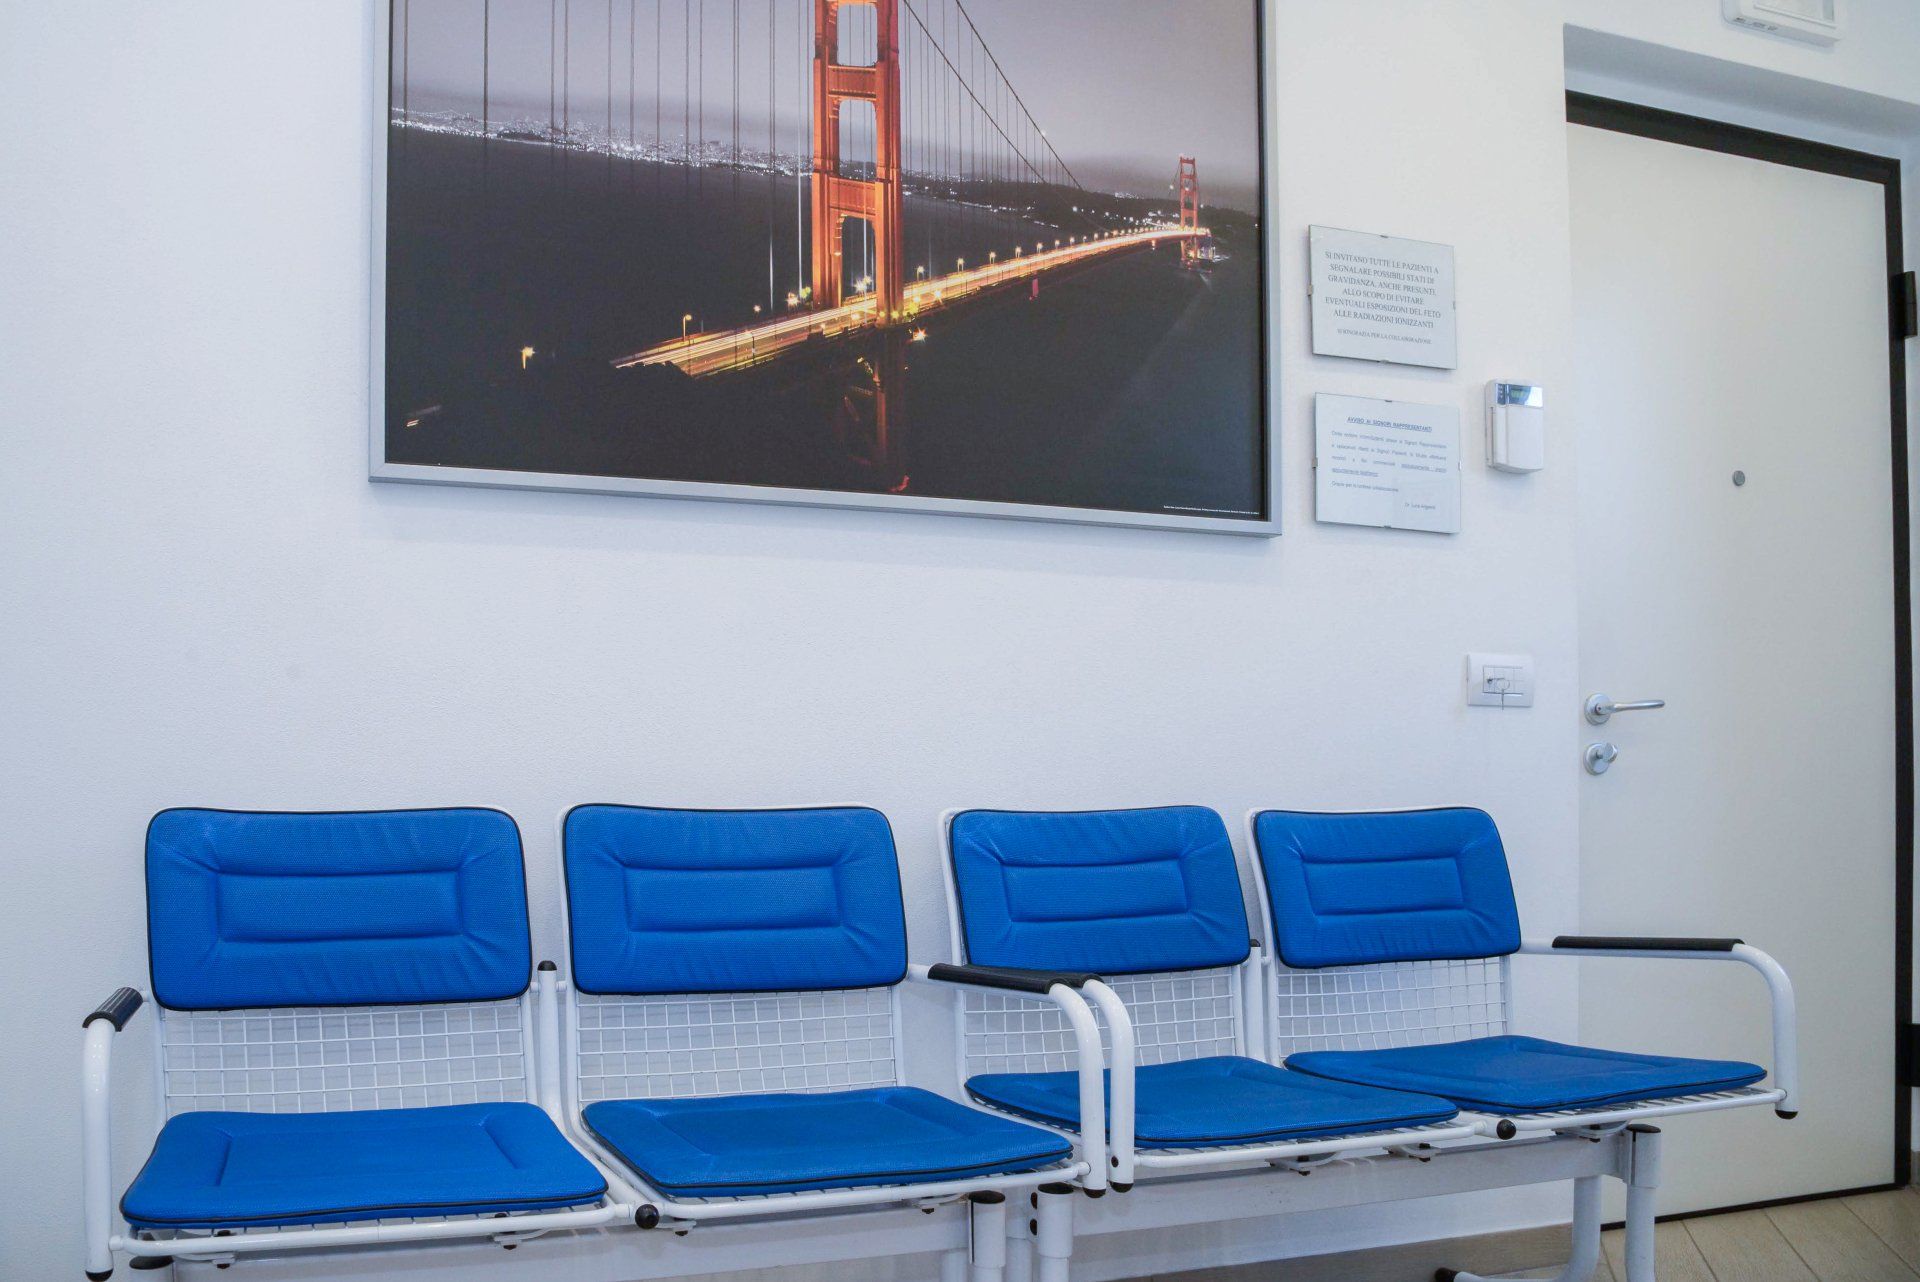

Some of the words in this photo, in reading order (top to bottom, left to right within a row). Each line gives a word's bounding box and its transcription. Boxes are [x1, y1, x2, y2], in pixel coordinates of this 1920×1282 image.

[1333, 253, 1368, 264] INVITANO
[1370, 258, 1390, 267] TUTTE
[1402, 262, 1433, 273] PAZIENTI
[1330, 264, 1372, 275] SEGNALARE
[1374, 270, 1405, 281] POSSIBILI
[1407, 274, 1426, 283] STATI
[1378, 282, 1401, 290] ANCHE
[1343, 289, 1361, 297] ALLO
[1362, 291, 1385, 300] SCOPO
[1395, 295, 1424, 304] EVITARE
[1326, 297, 1365, 308] EVENTUALI
[1366, 302, 1408, 313] ESPOSIZIONI
[1409, 307, 1422, 315] DEL
[1424, 310, 1441, 318] FETO
[1334, 309, 1352, 317] ALLE
[1353, 312, 1394, 323] RADIAZIONI
[1395, 317, 1433, 328] IONIZZANTI
